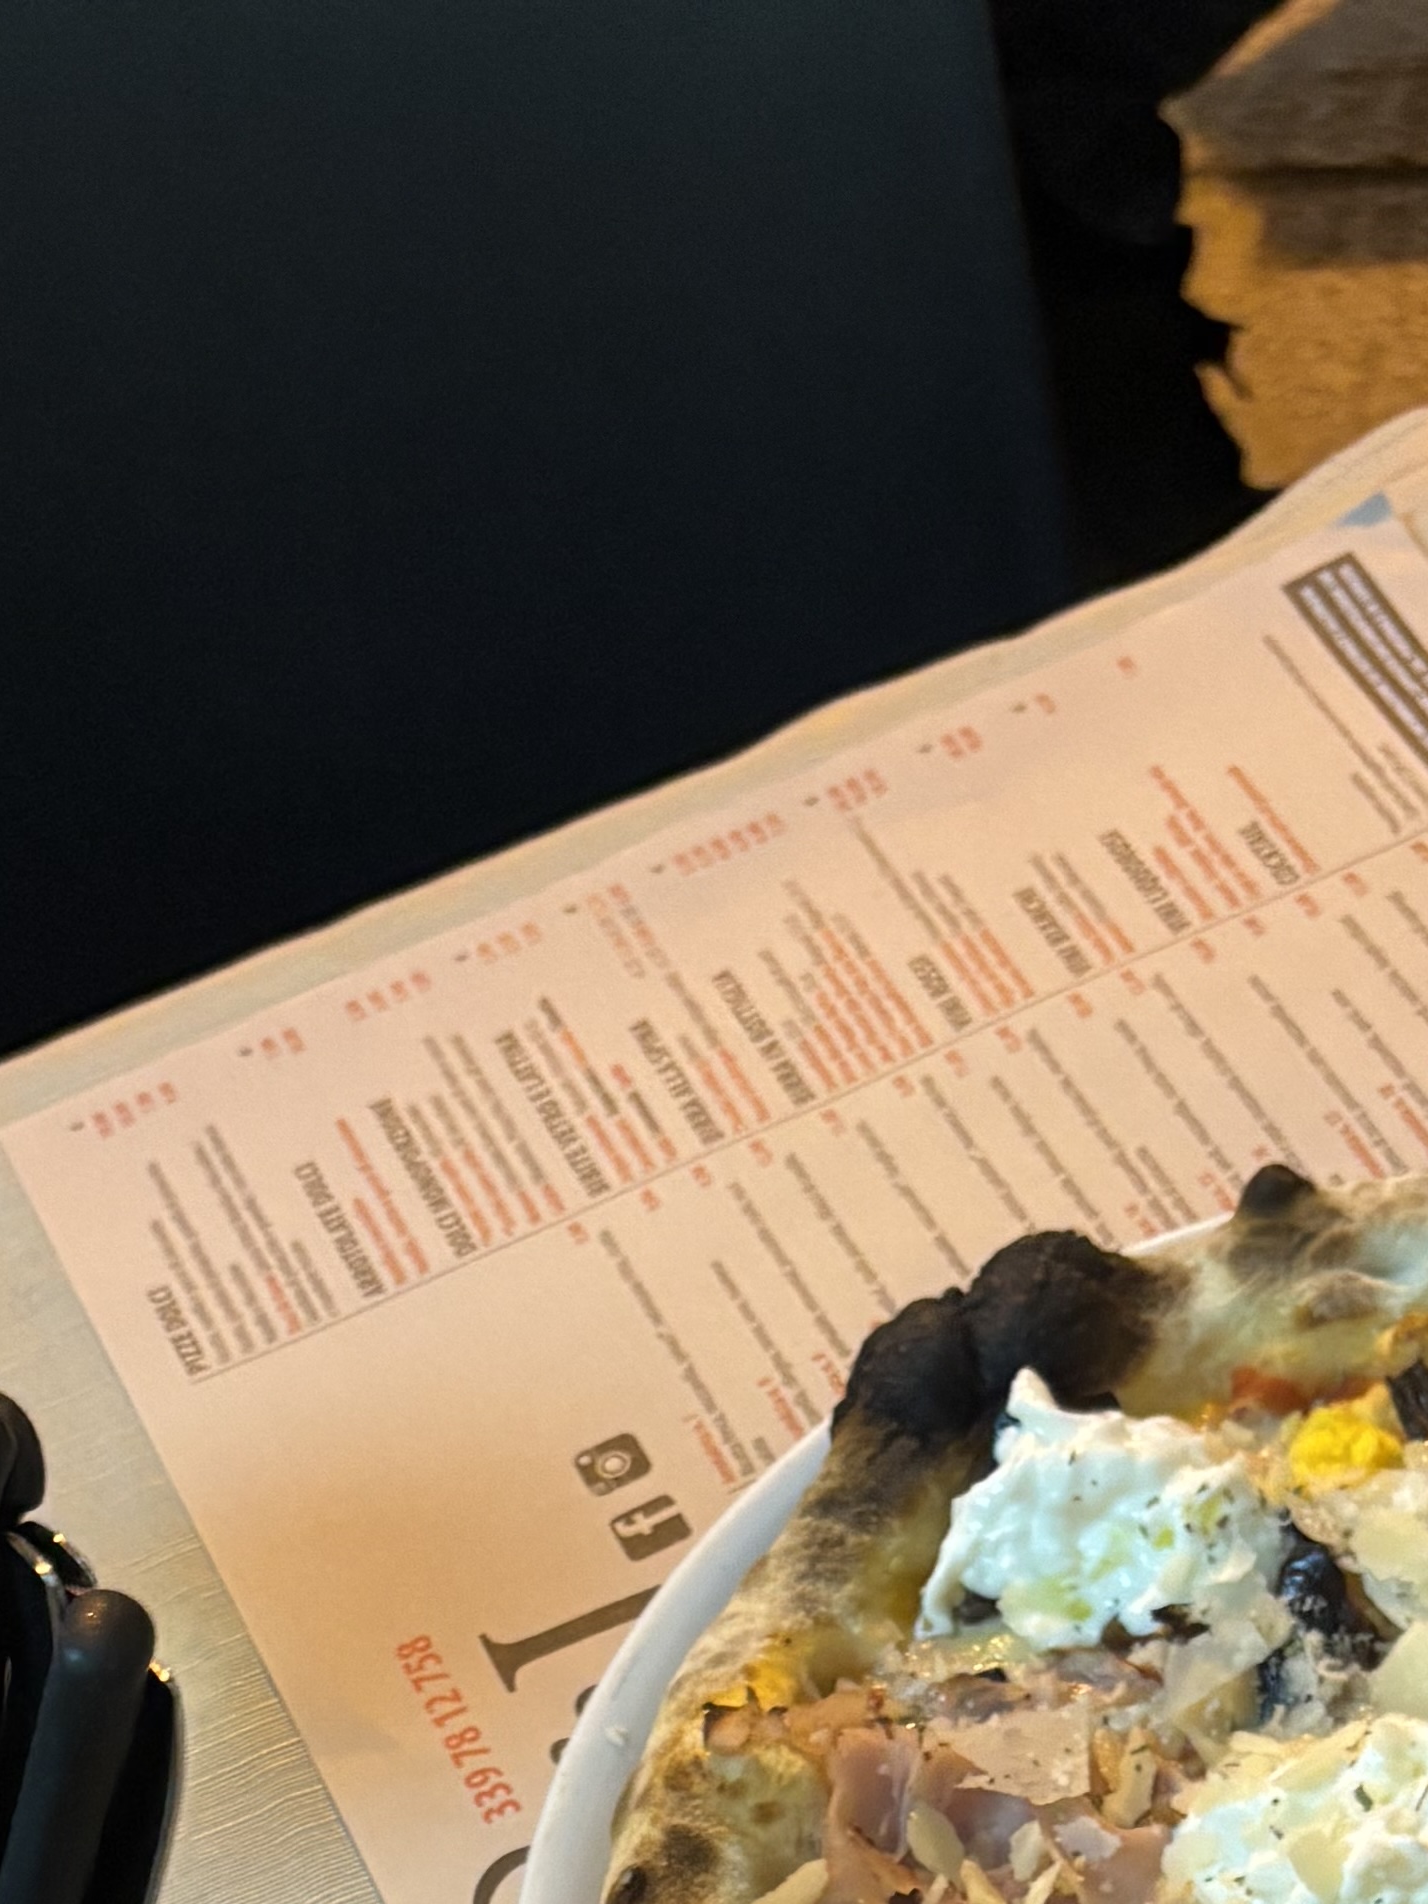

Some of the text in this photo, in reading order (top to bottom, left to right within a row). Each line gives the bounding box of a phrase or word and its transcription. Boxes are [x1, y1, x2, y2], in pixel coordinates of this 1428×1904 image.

[396, 1634, 521, 1824] 339 78 12 758
